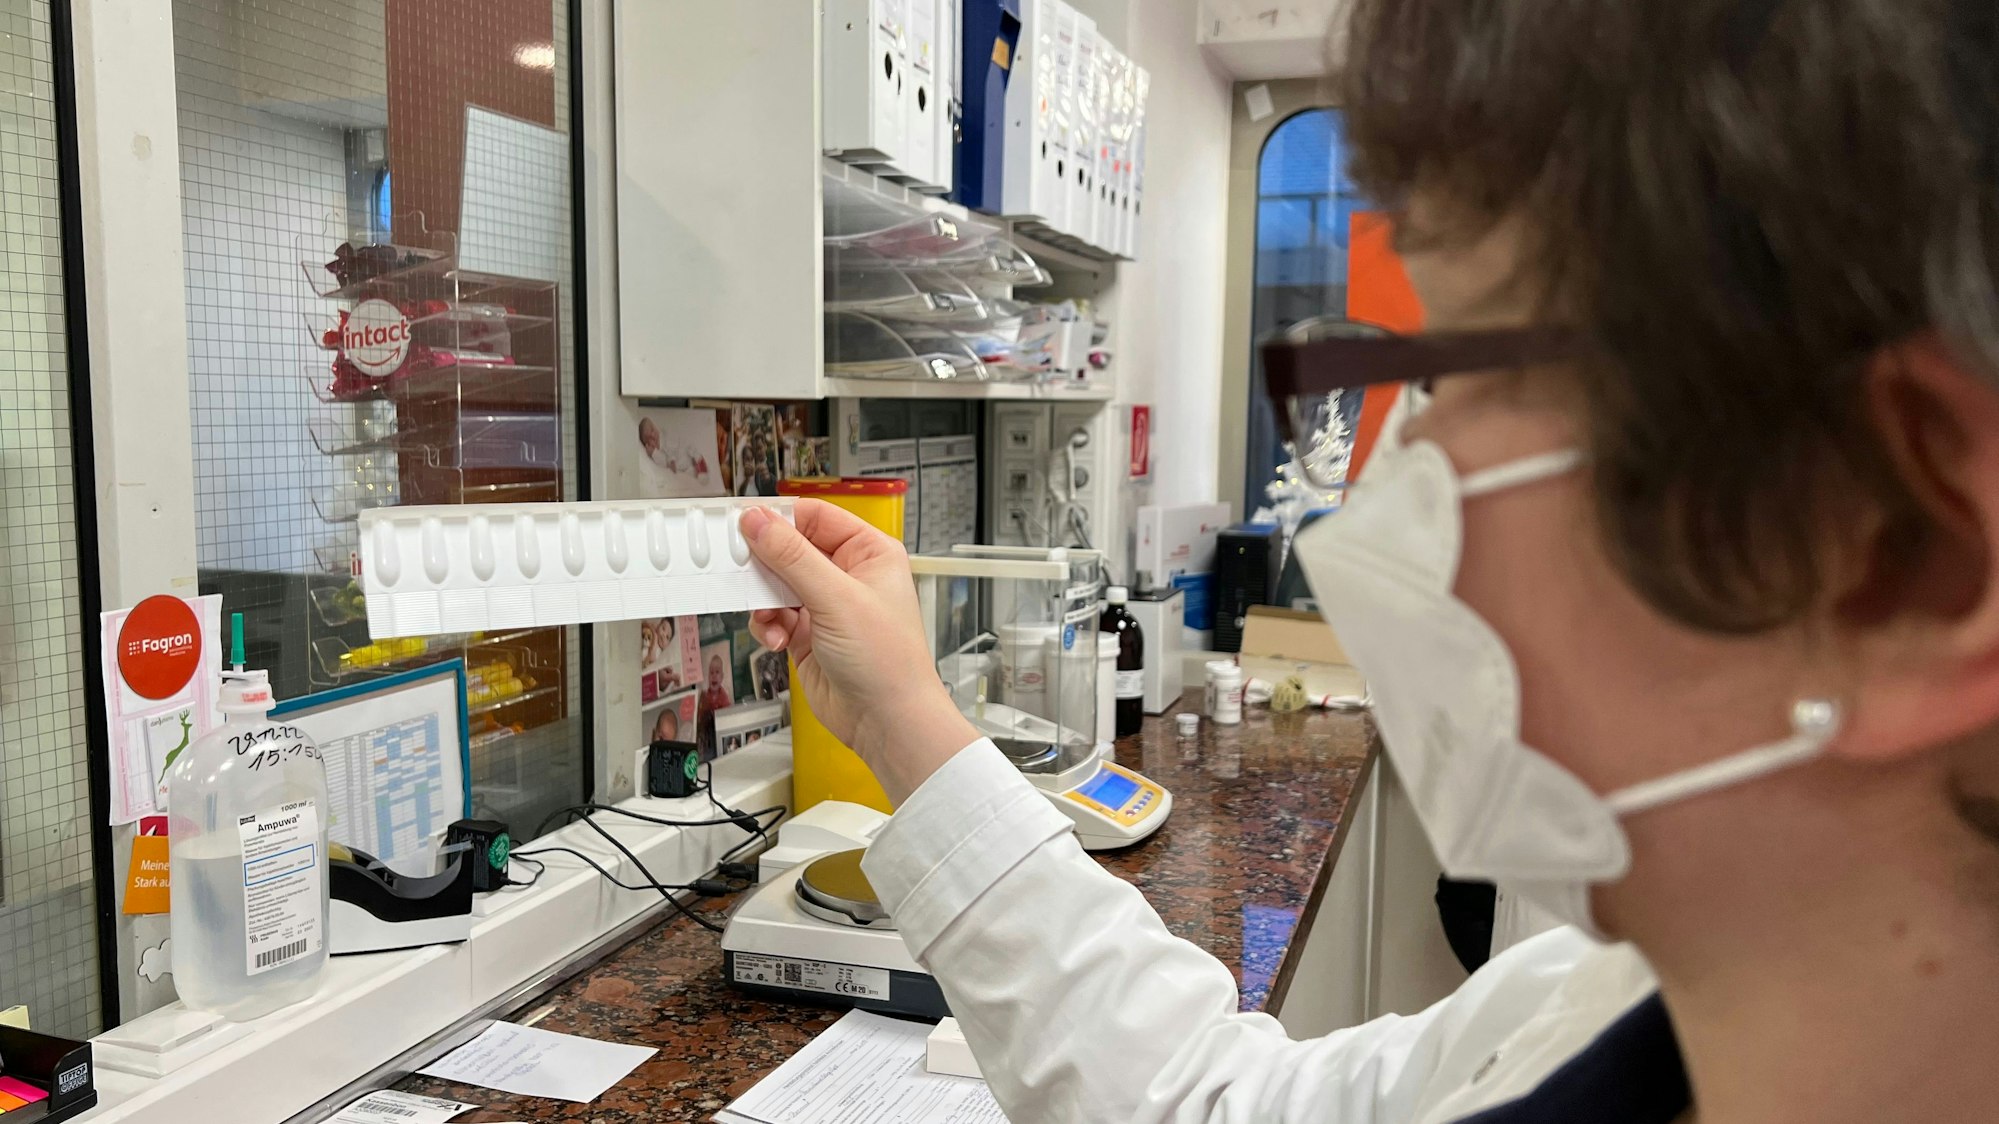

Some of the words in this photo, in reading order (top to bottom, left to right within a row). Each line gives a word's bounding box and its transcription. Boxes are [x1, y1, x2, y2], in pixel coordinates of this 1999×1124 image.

[345, 320, 410, 350] intact
[142, 633, 193, 654] Fagron
[281, 803, 298, 812] 1000
[140, 860, 169, 870] Meine
[134, 877, 157, 888] Stark
[60, 1064, 86, 1082] TIPTOP
